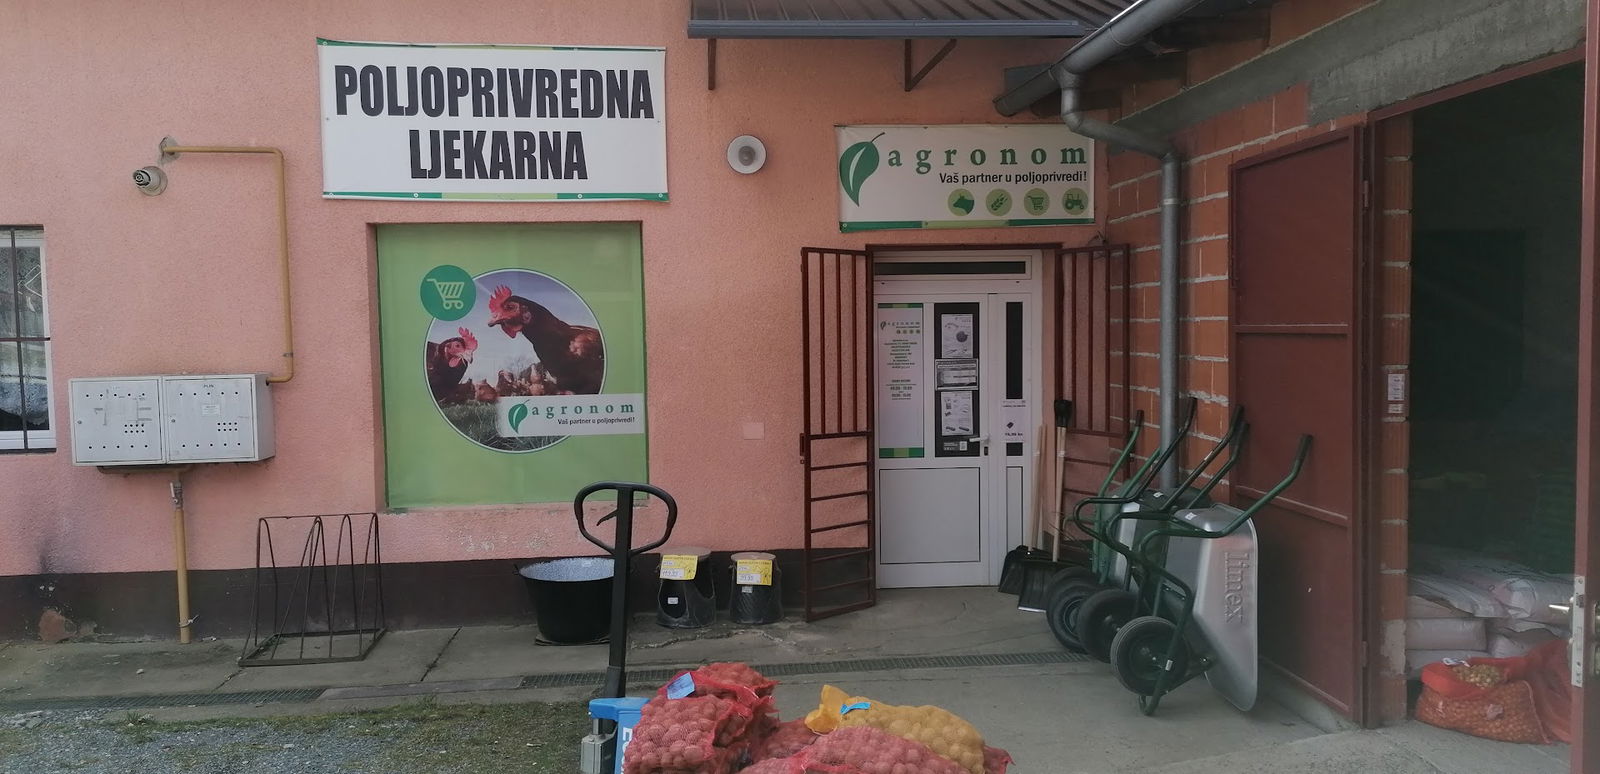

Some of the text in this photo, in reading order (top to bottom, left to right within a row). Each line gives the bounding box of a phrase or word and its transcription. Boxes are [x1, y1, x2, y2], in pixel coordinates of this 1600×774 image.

[334, 64, 655, 119] POLJOPRIVREDNA
[408, 129, 588, 180] LJEKARNA
[887, 146, 1087, 175] agronom
[939, 170, 1087, 186] Vaš partner u poljoprivredi!
[531, 403, 634, 419] agronom
[569, 418, 591, 426] partner
[596, 416, 635, 425] poljoprivredi!
[1224, 551, 1250, 624] limex
